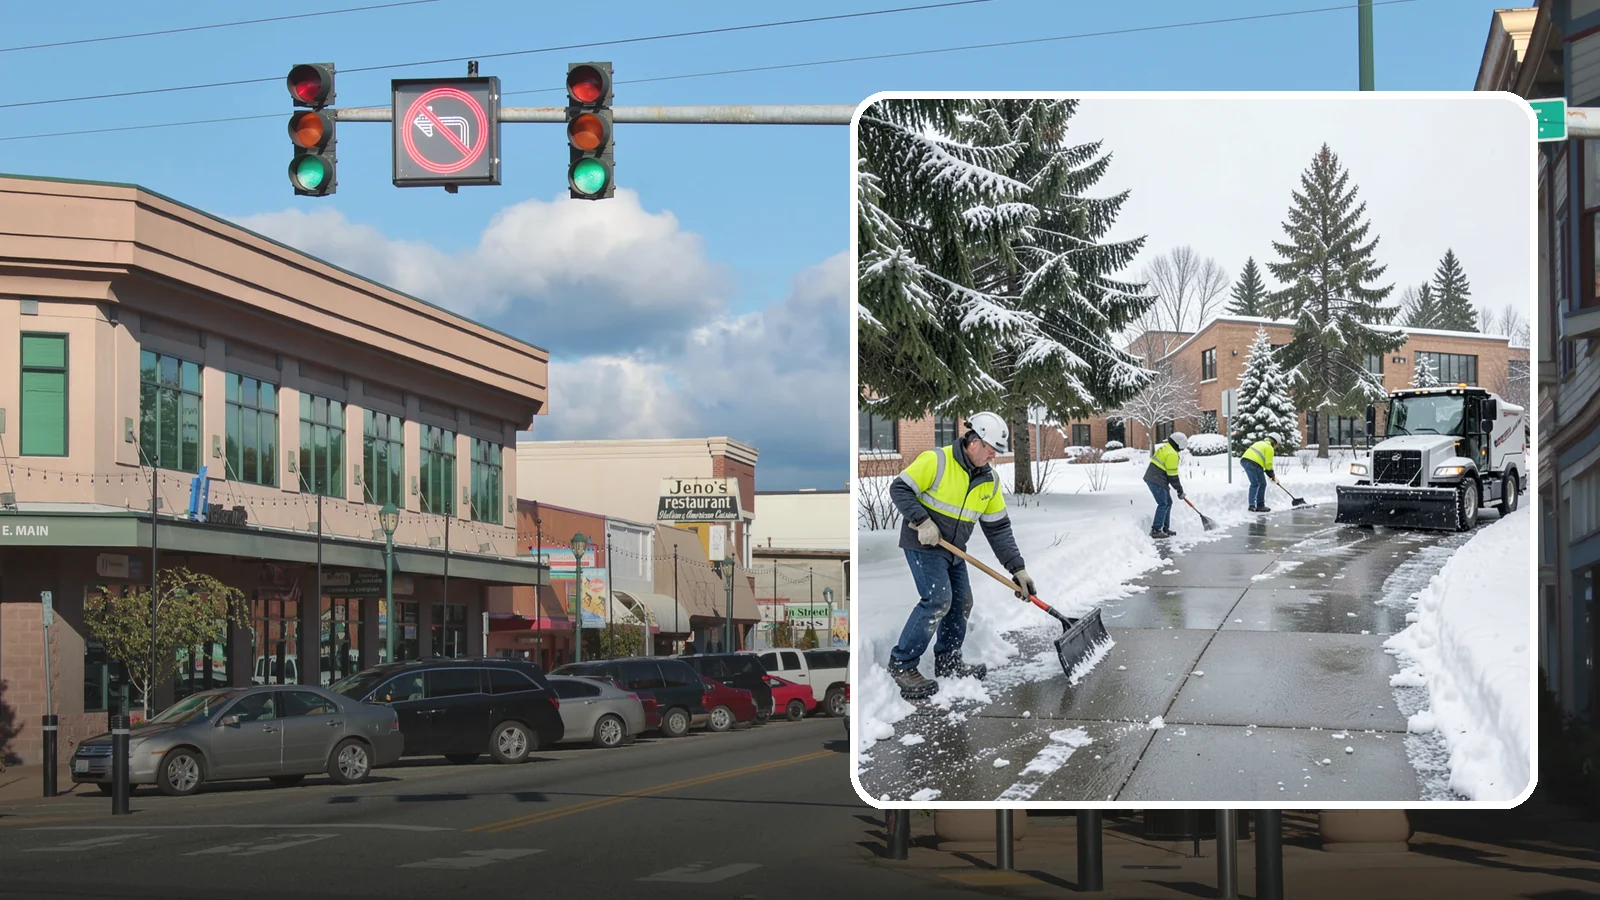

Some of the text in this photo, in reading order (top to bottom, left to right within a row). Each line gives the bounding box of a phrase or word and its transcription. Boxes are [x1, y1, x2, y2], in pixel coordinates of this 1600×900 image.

[670, 480, 727, 494] Jeno's
[665, 497, 730, 509] restaurant
[658, 510, 681, 519] Italian
[686, 510, 714, 519] American
[715, 510, 738, 519] Cuisine
[2, 526, 49, 536] E. MAIN
[797, 607, 829, 617] Street
